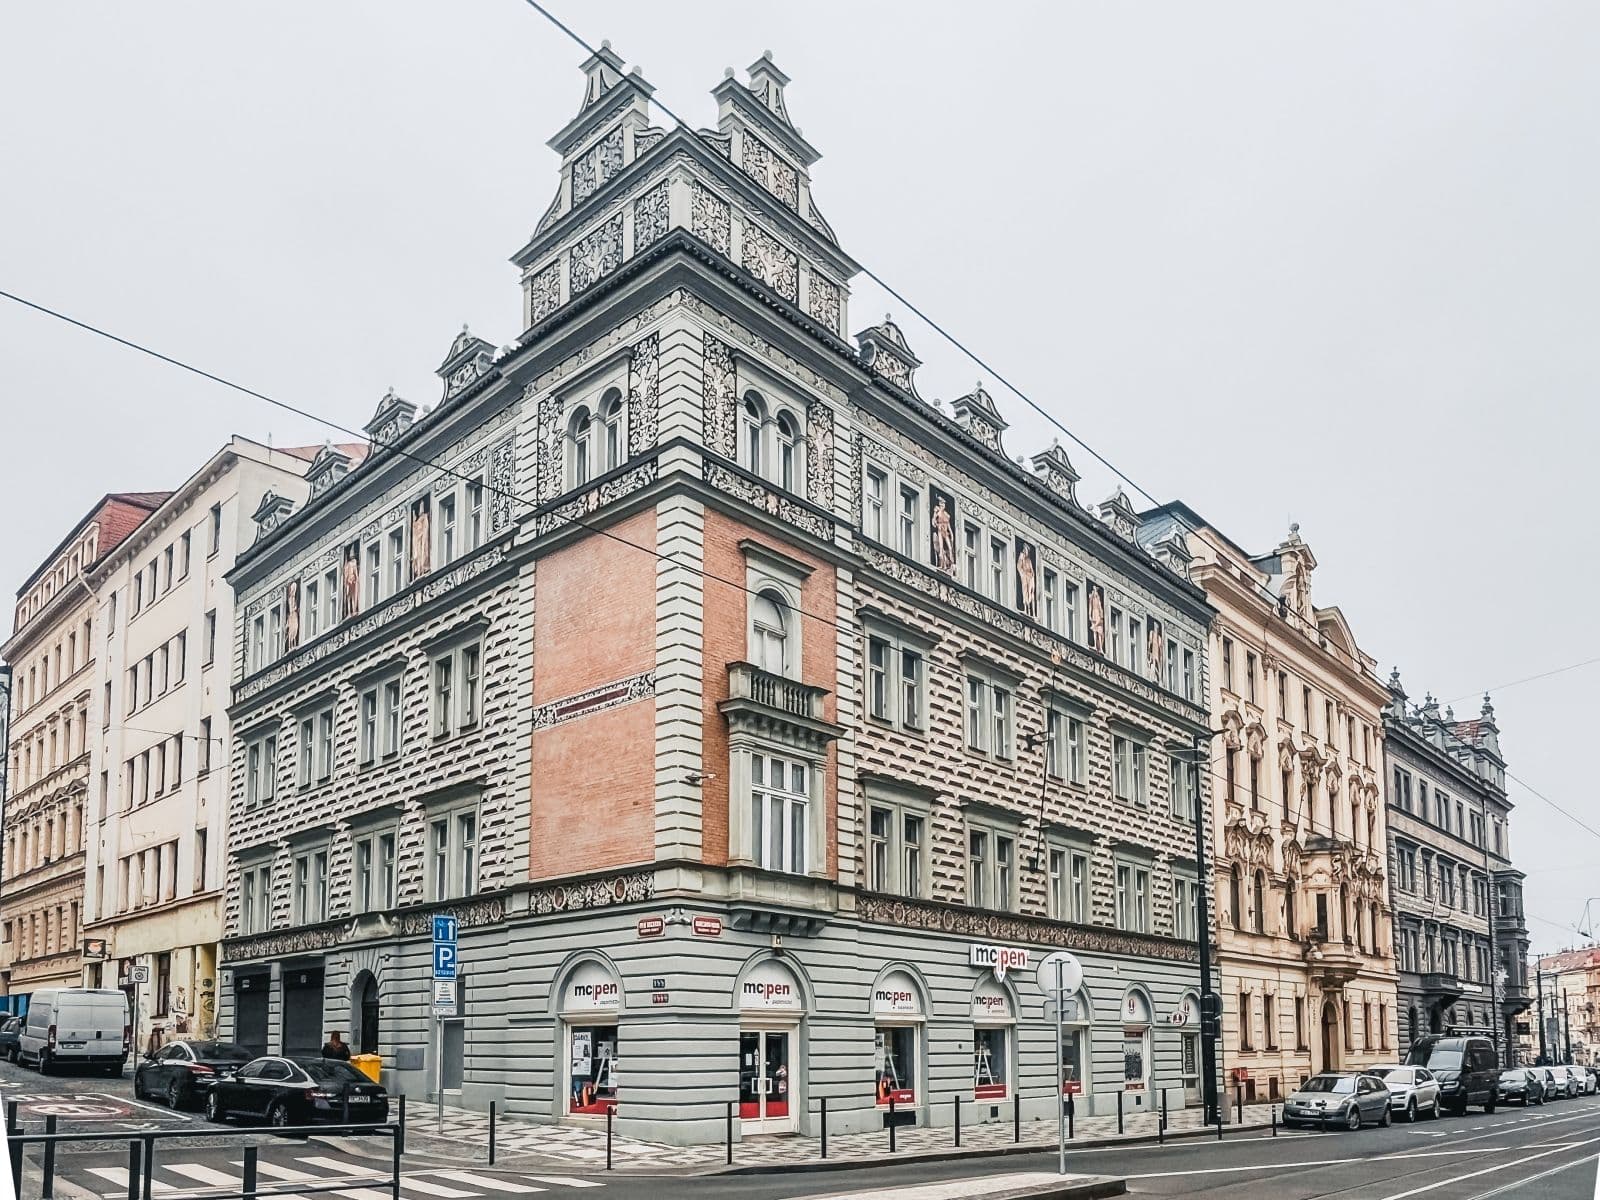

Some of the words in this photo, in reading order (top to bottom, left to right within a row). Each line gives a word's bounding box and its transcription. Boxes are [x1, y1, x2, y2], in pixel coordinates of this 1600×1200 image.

[439, 948, 453, 968] P
[976, 947, 1026, 971] mcpen
[574, 983, 618, 1001] mcpen
[743, 982, 790, 1000] mcpen
[875, 990, 912, 1005] mcpen
